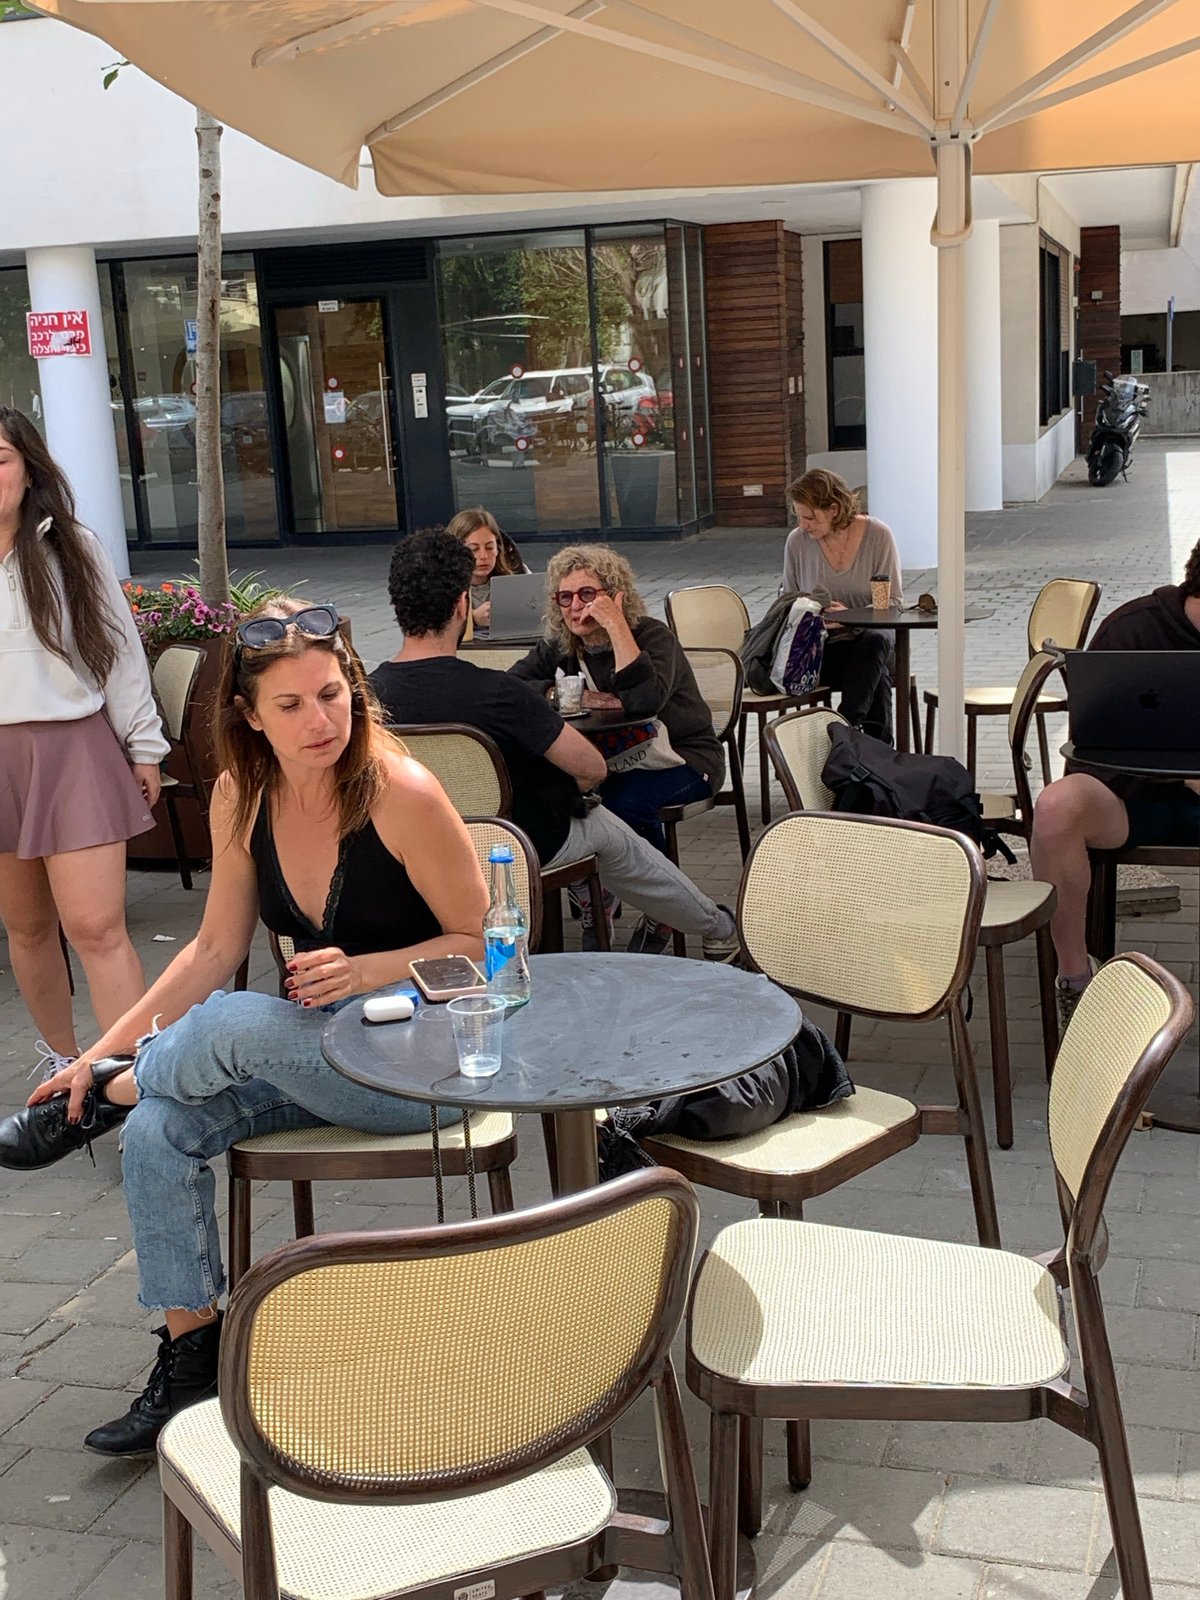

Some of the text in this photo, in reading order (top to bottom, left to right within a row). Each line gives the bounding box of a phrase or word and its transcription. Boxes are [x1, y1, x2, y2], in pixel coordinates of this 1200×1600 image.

[30, 312, 84, 328] אין חניה
[31, 329, 54, 341] לרכב
